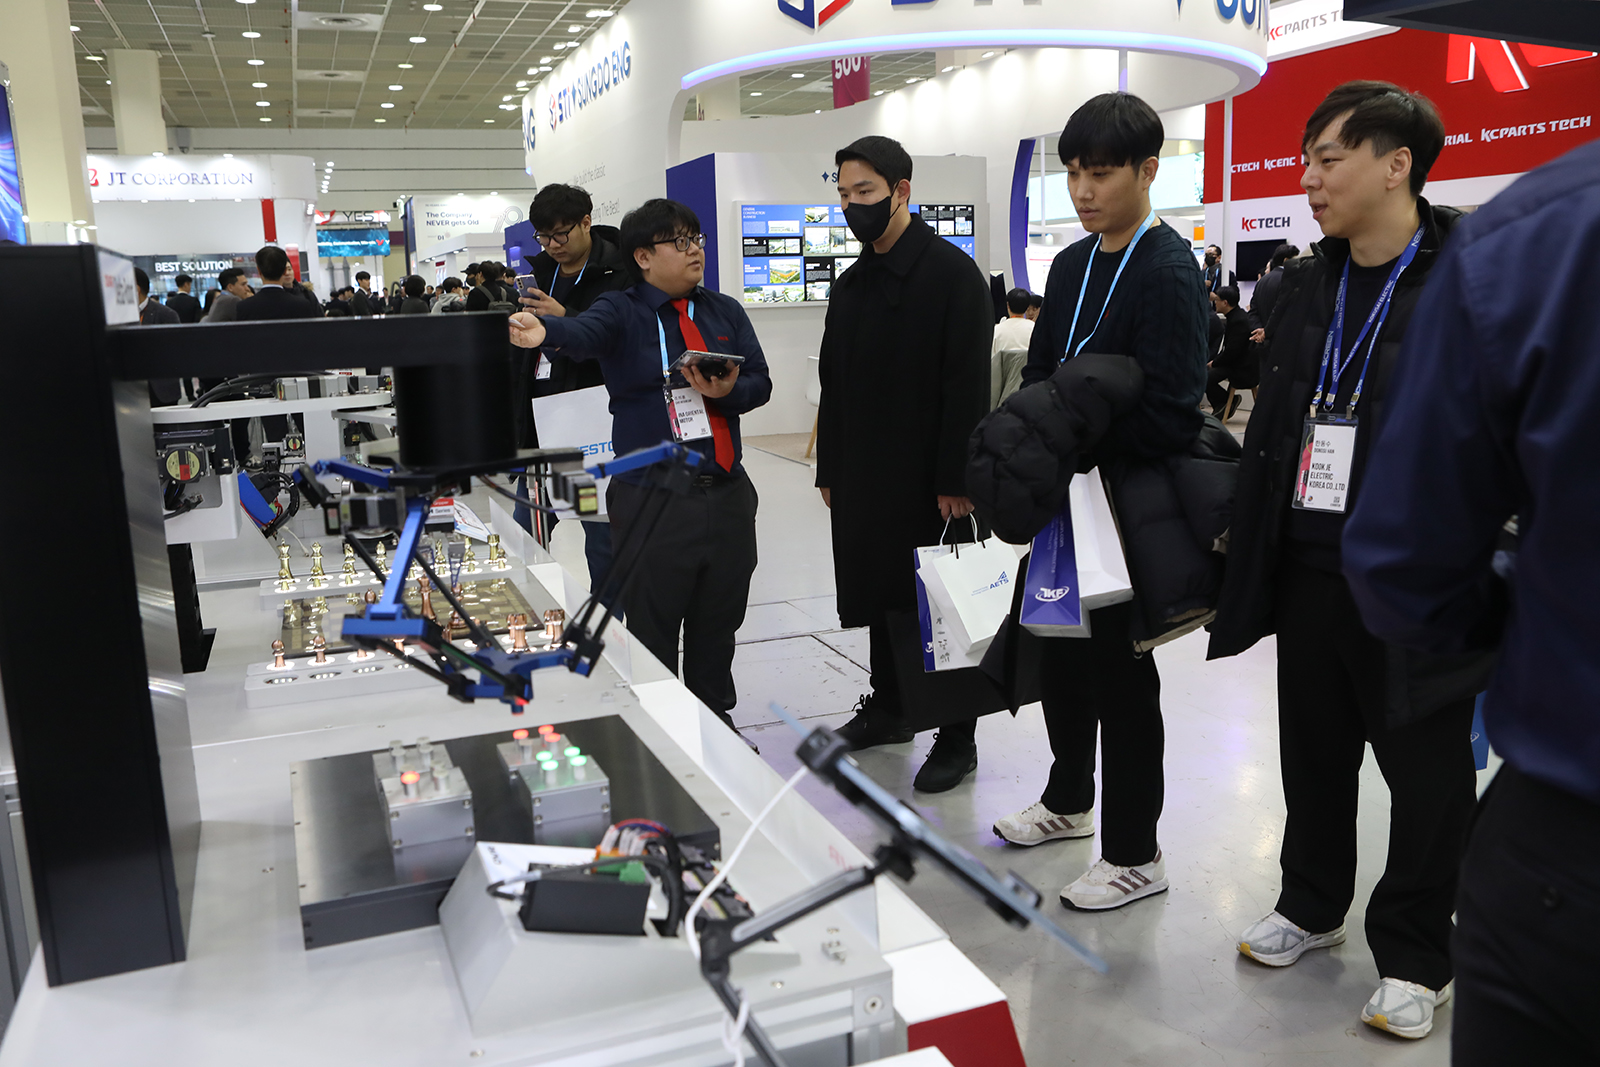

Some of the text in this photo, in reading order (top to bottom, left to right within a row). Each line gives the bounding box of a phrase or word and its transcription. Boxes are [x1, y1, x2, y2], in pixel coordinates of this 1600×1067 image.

[578, 56, 610, 109] SUNGDO
[612, 41, 631, 85] ENG
[1444, 133, 1473, 146] RIAL
[1231, 161, 1260, 173] CTECH
[108, 172, 253, 186] JT CORPORATION
[154, 260, 233, 272] BEST SOLUTION
[1379, 280, 1394, 303] ELECTRIC
[1322, 330, 1334, 366] SCREEN
[576, 440, 614, 457] ESTO
[1310, 471, 1334, 480] ELECTRIC
[1309, 481, 1325, 489] KOREA
[990, 578, 1009, 590] AETS
